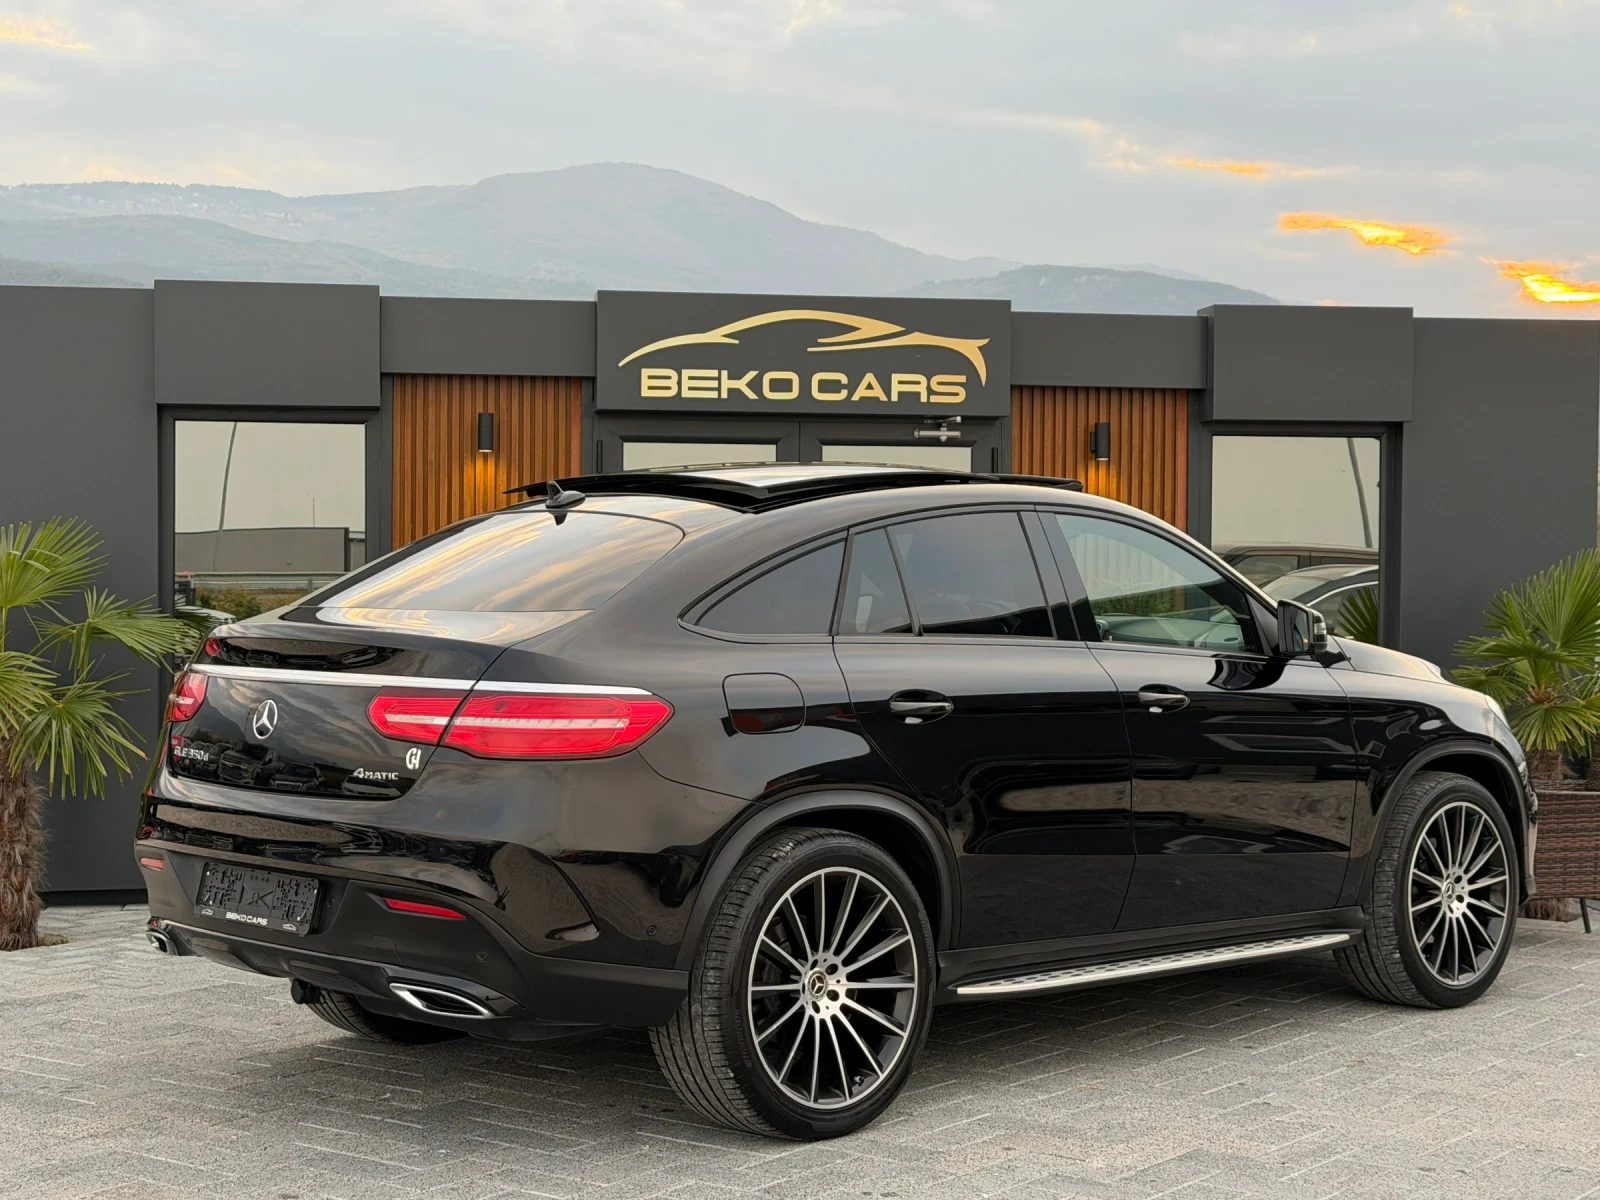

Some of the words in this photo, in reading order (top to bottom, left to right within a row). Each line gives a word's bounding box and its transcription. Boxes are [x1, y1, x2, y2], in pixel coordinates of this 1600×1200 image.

[640, 368, 800, 400] BEKO
[811, 372, 967, 404] CARS
[352, 767, 399, 780] 4MATIC
[225, 911, 247, 922] BEKO
[246, 915, 269, 926] CARS
